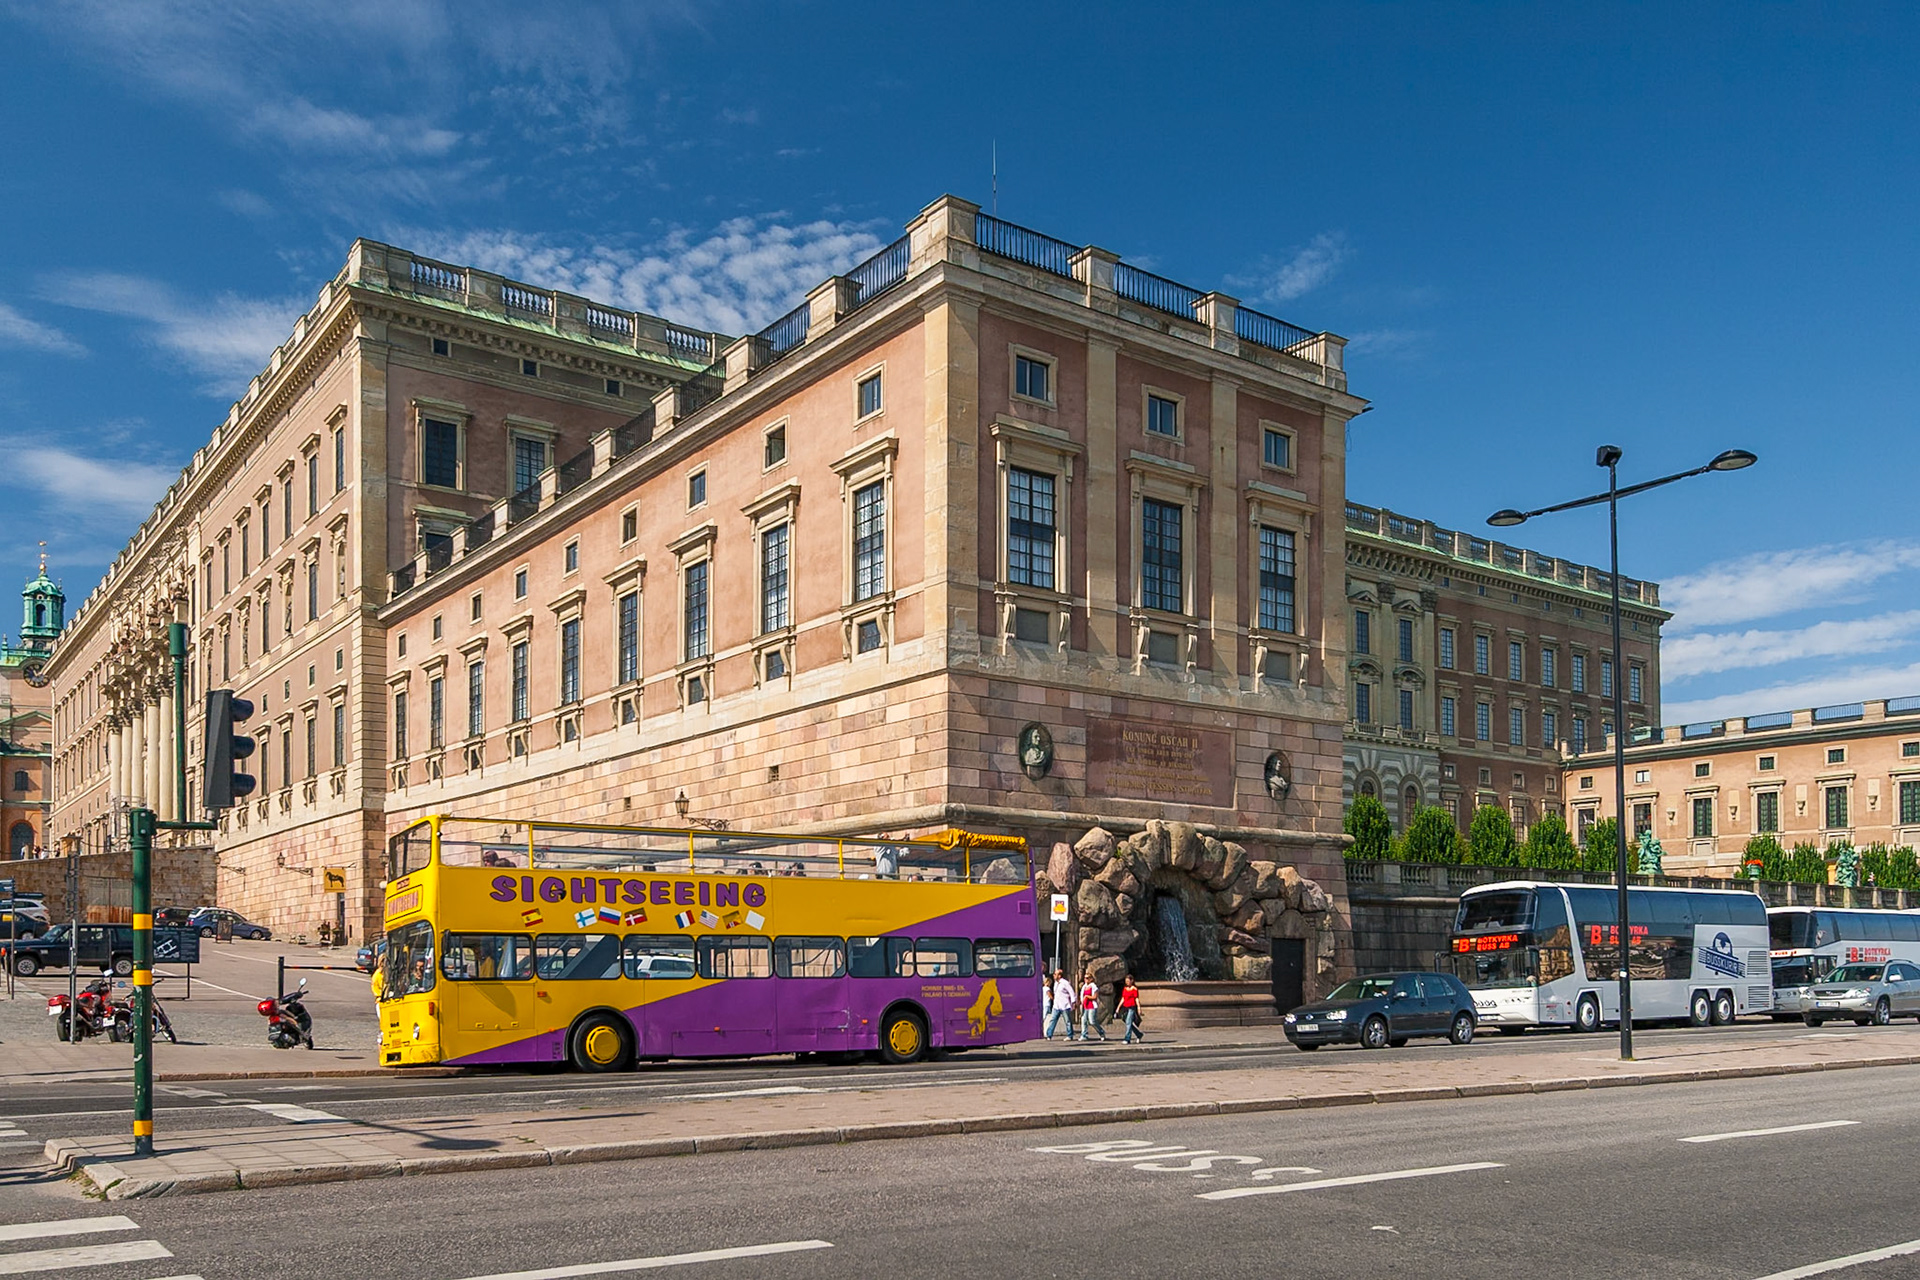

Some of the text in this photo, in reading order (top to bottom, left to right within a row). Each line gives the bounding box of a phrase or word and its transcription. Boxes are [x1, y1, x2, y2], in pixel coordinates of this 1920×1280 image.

[1122, 730, 1157, 745] KONUNG
[1160, 734, 1188, 748] OSCAR
[490, 875, 767, 907] SIGHTSEEING
[1591, 924, 1602, 945] B
[1610, 925, 1649, 936] BOYRKA
[1458, 938, 1470, 952] B
[1477, 934, 1518, 944] BOTKYRKA
[1476, 941, 1510, 952] BUSS AB
